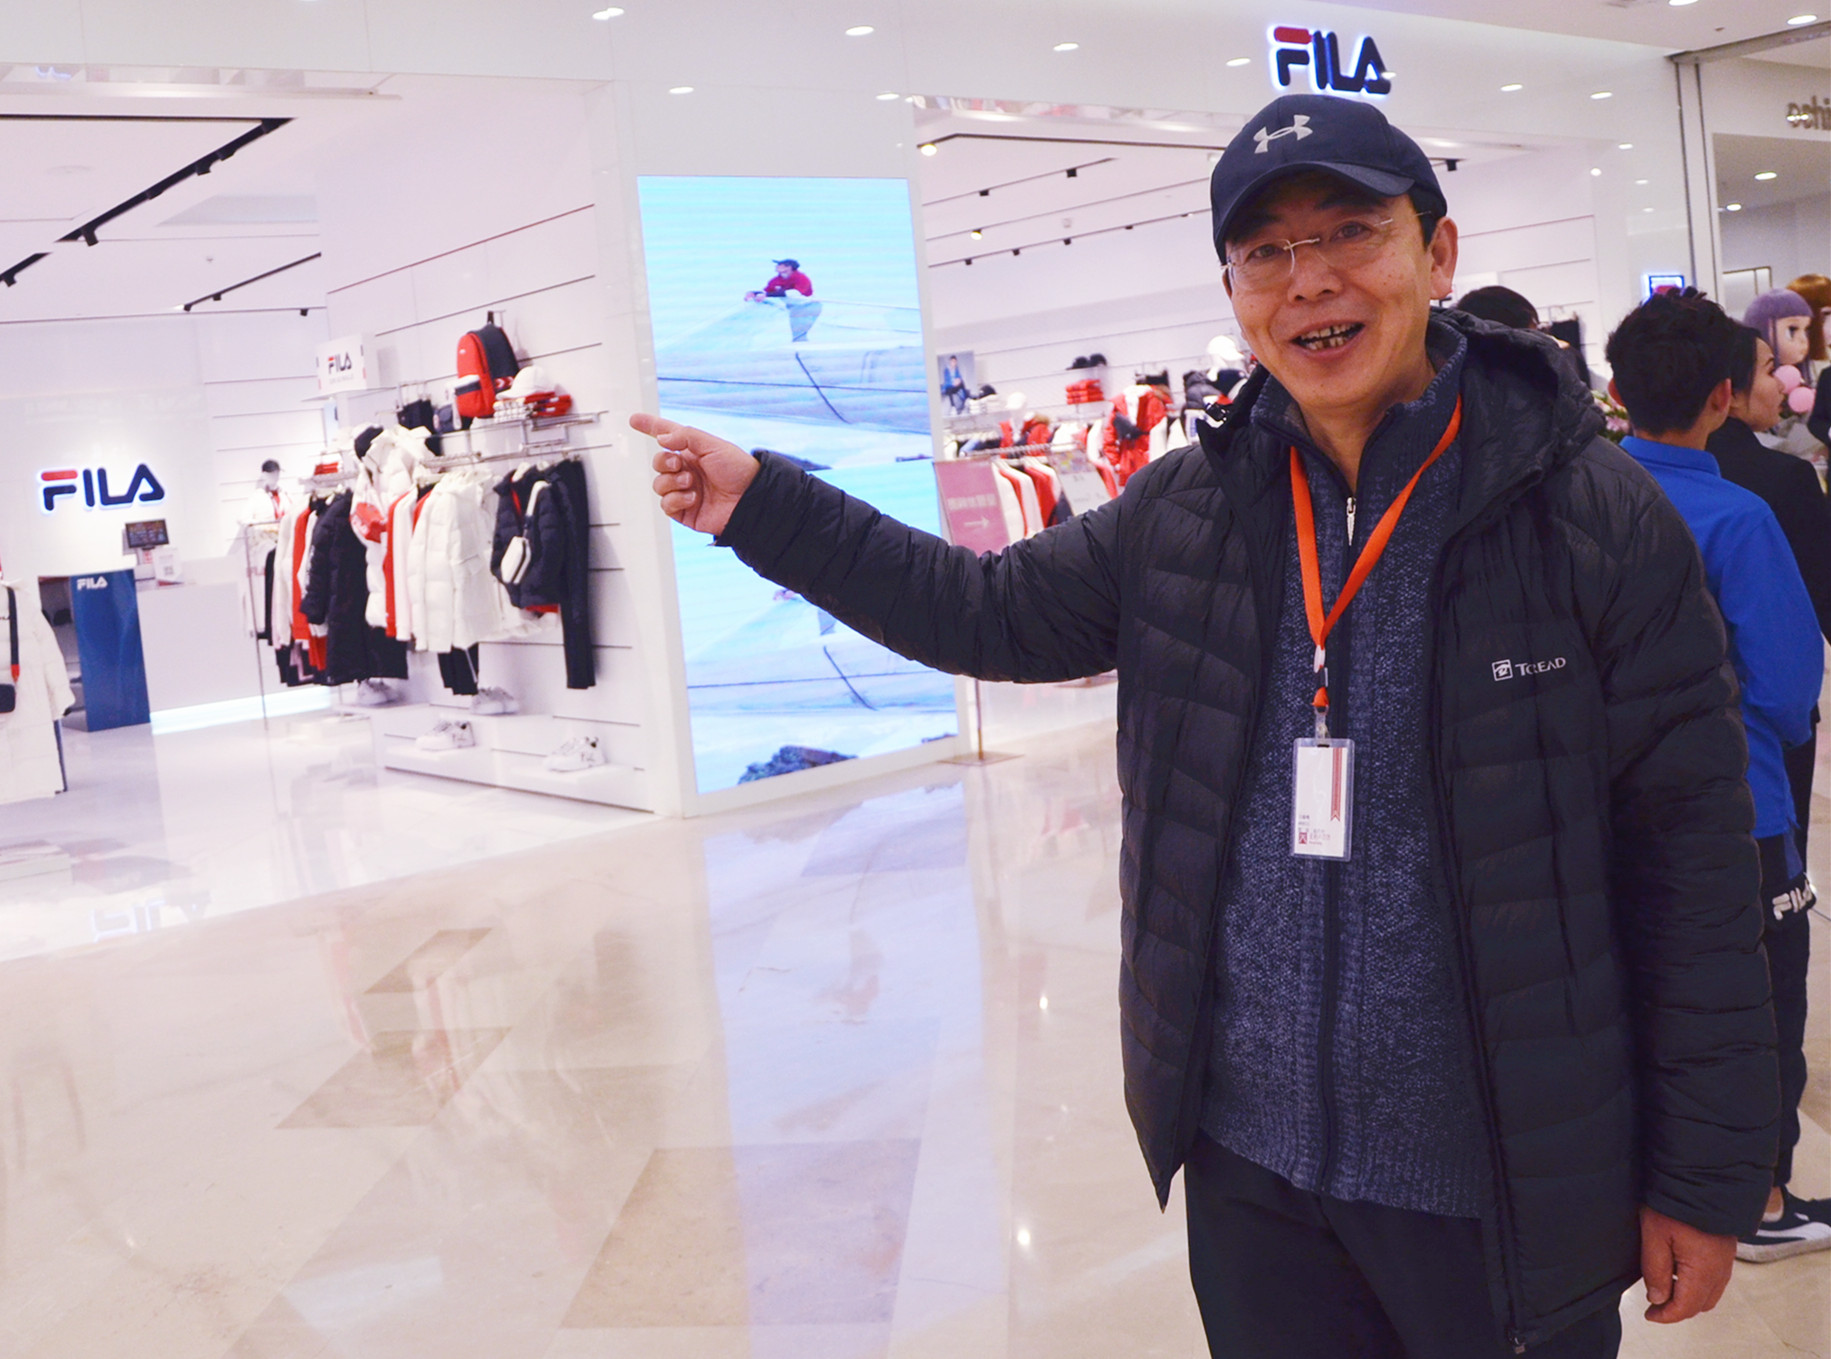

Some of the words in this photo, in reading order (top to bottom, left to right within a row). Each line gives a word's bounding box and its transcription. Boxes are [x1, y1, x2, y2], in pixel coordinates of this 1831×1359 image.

[1273, 26, 1391, 95] FILA
[328, 351, 352, 375] FILA
[40, 463, 165, 511] FILA
[77, 576, 108, 591] FILA
[1772, 880, 1813, 920] FILA
